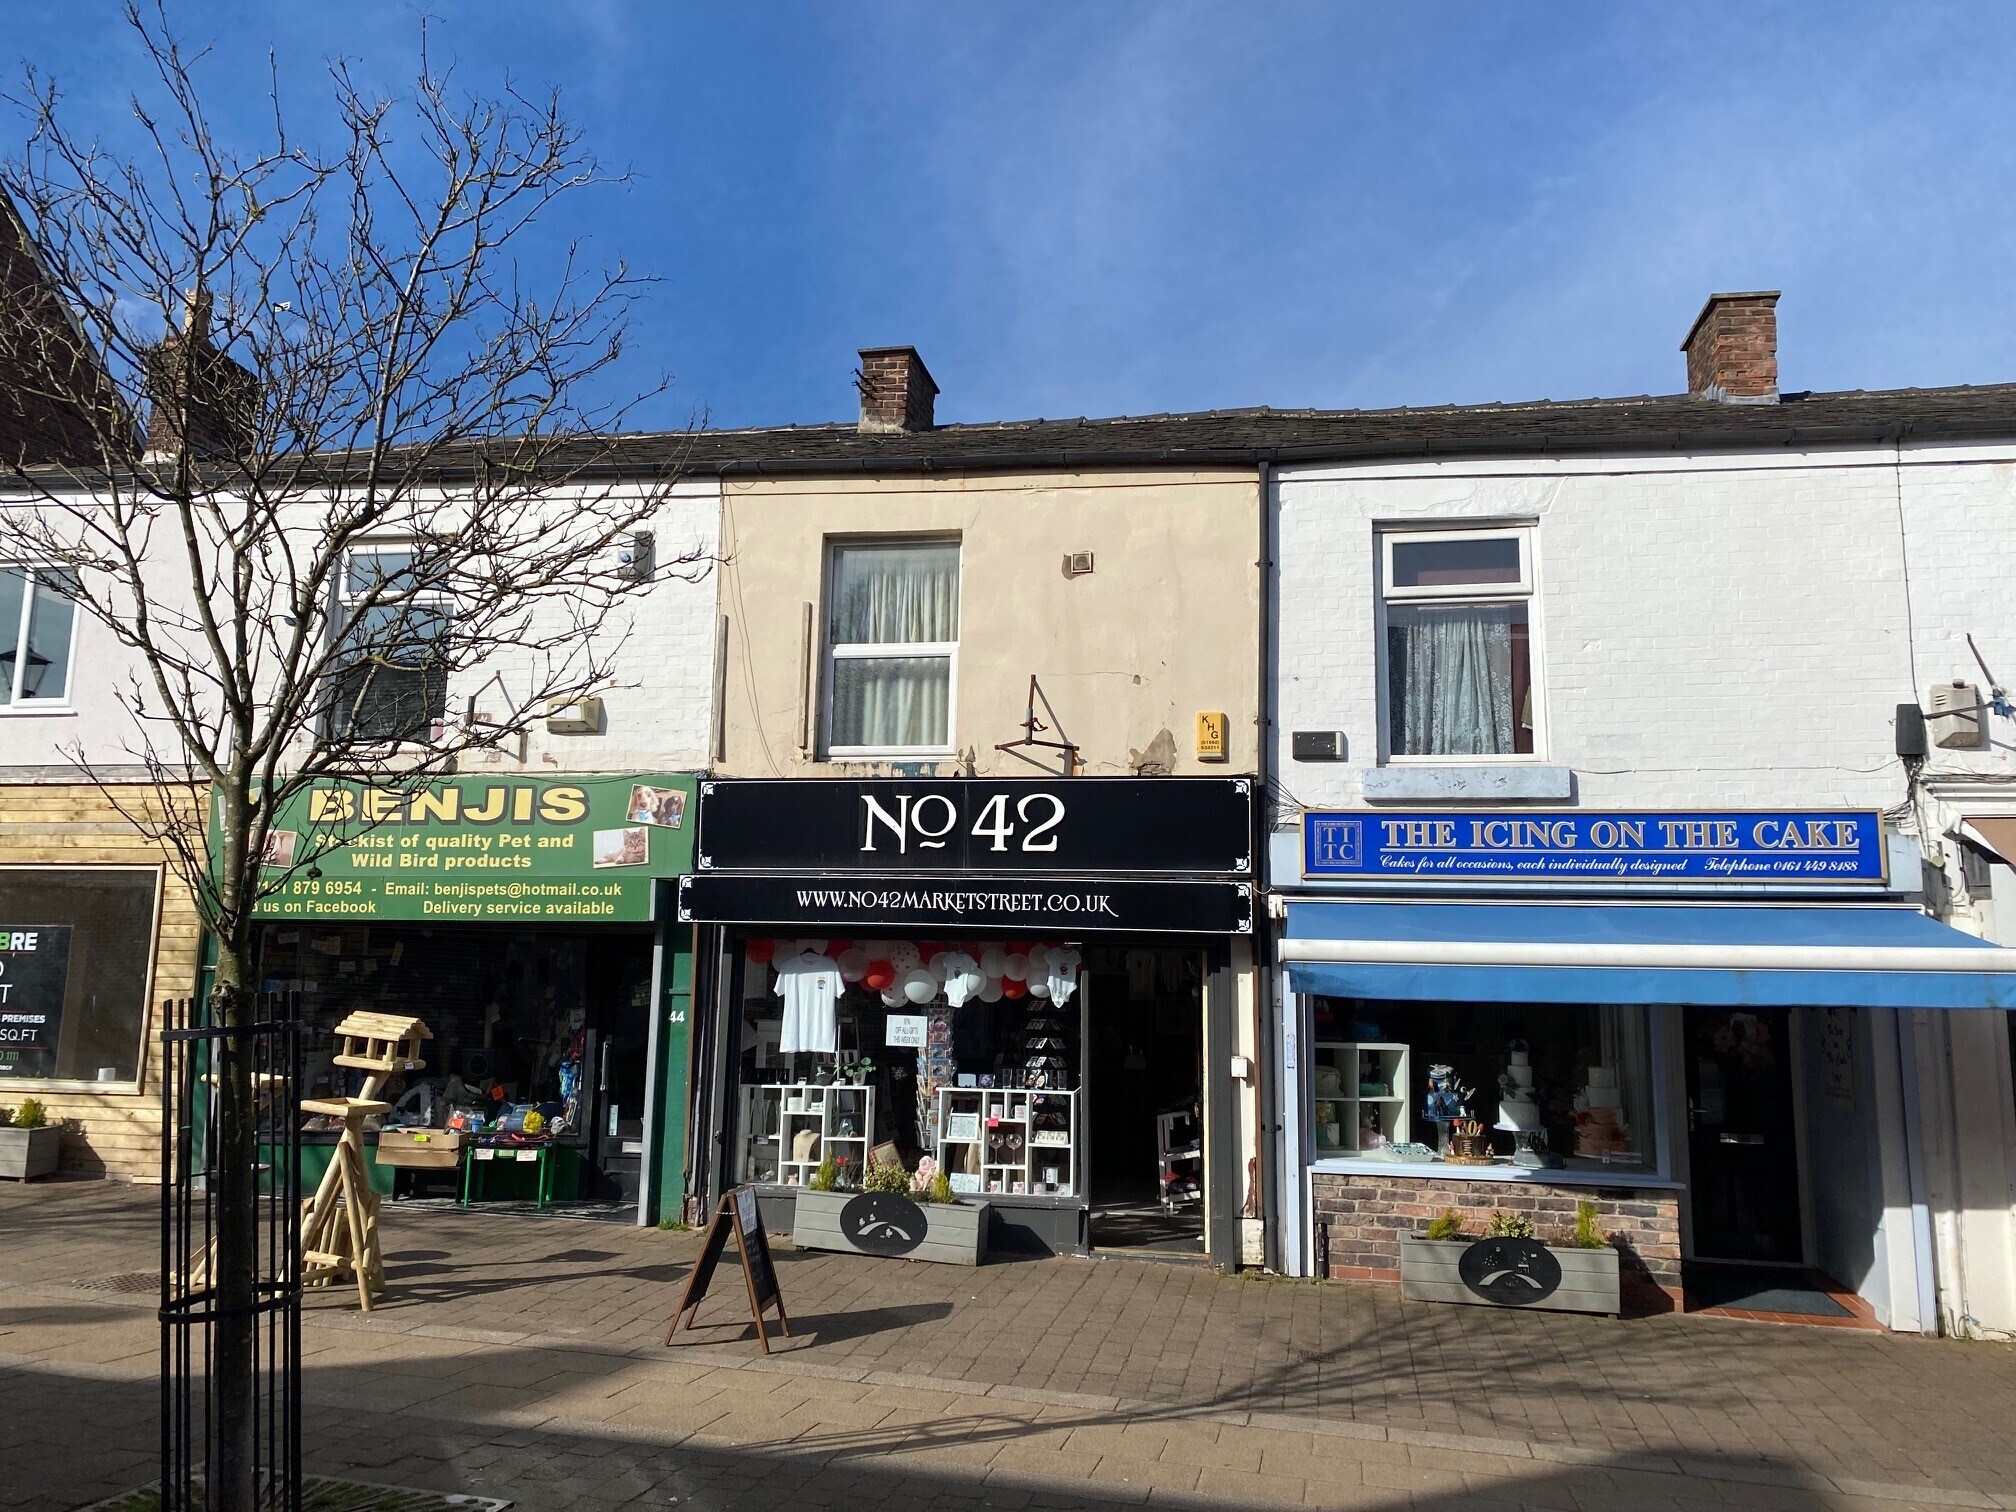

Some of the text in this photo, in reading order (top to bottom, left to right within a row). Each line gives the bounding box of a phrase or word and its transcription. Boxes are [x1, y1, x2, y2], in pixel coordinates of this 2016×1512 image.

[307, 786, 590, 826] BENJIS
[971, 793, 1065, 852] 42
[315, 833, 574, 851] Stckist of quality Pet and
[1381, 820, 1457, 848] THE
[1470, 820, 1578, 848] ICING
[1590, 821, 1646, 848] ON
[1658, 821, 1740, 848] THE
[1752, 821, 1860, 849] CAKE
[351, 853, 532, 870] Wild Bird products
[1380, 855, 1859, 875] Cakes for all occasions, each individually designed Telephone 0161 449 8188
[293, 881, 320, 895] 879
[325, 881, 362, 895] 6954
[385, 881, 429, 895] Email:
[434, 883, 622, 899] benjispets@hotmail.co.uk
[263, 901, 280, 912] us
[284, 901, 302, 912] on
[306, 900, 376, 914] Facebook
[423, 900, 481, 917] Delivery
[487, 902, 541, 915] service
[545, 901, 615, 916] available
[796, 890, 1119, 918] WWW.NO42MARKETSTREET.CO.UK
[1, 1014, 46, 1024] PREMISES
[668, 1010, 685, 1023] 44
[0, 1028, 38, 1041] SQ.FT
